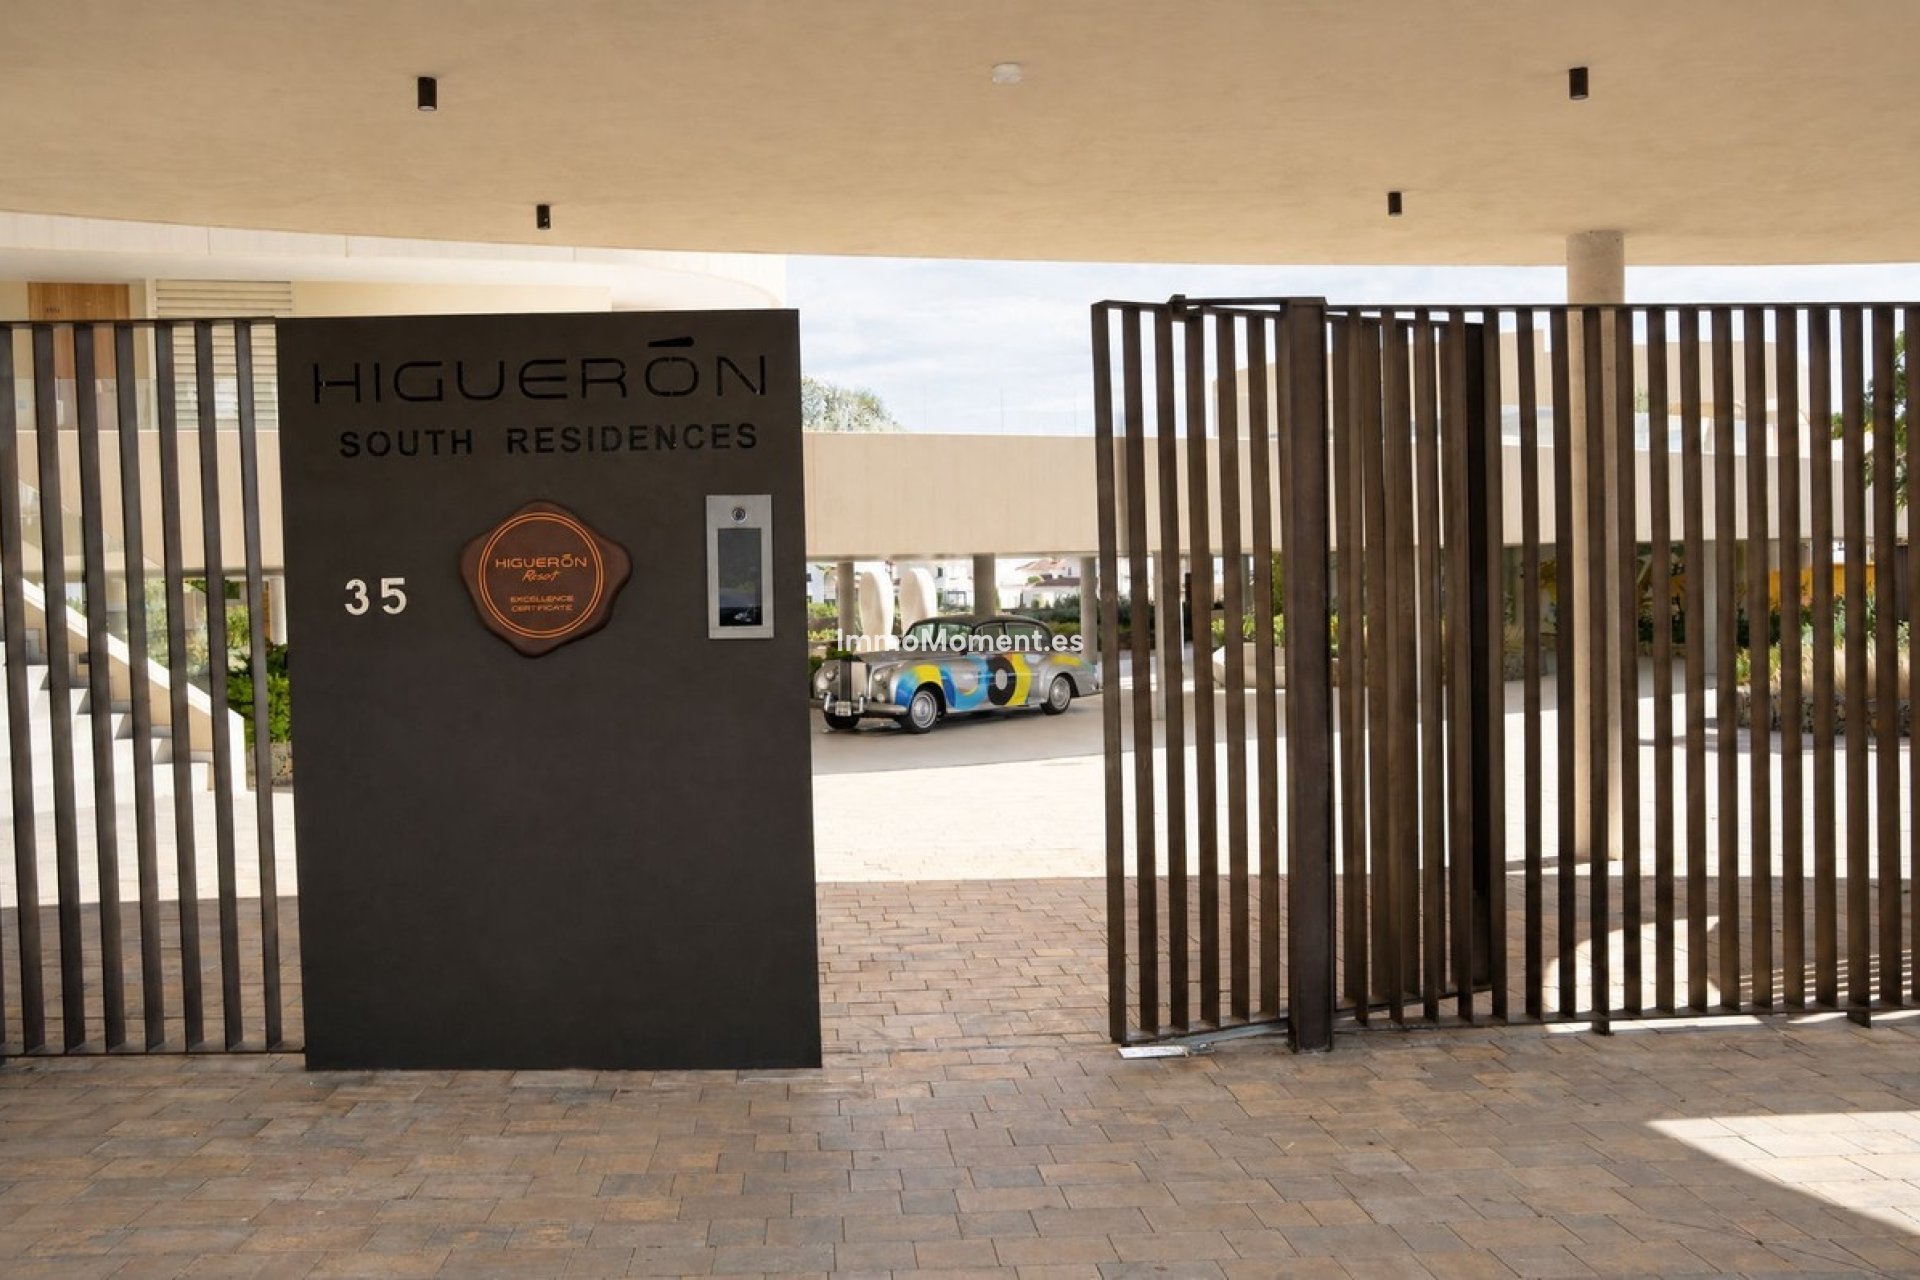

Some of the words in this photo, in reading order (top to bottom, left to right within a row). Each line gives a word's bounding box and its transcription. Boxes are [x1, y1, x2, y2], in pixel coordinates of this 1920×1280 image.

[339, 427, 474, 457] SOUTH
[506, 423, 758, 454] RESIDENCES
[344, 577, 407, 616] 35
[510, 595, 575, 603] EXCELLENCE
[511, 604, 573, 613] CERTIFICATE
